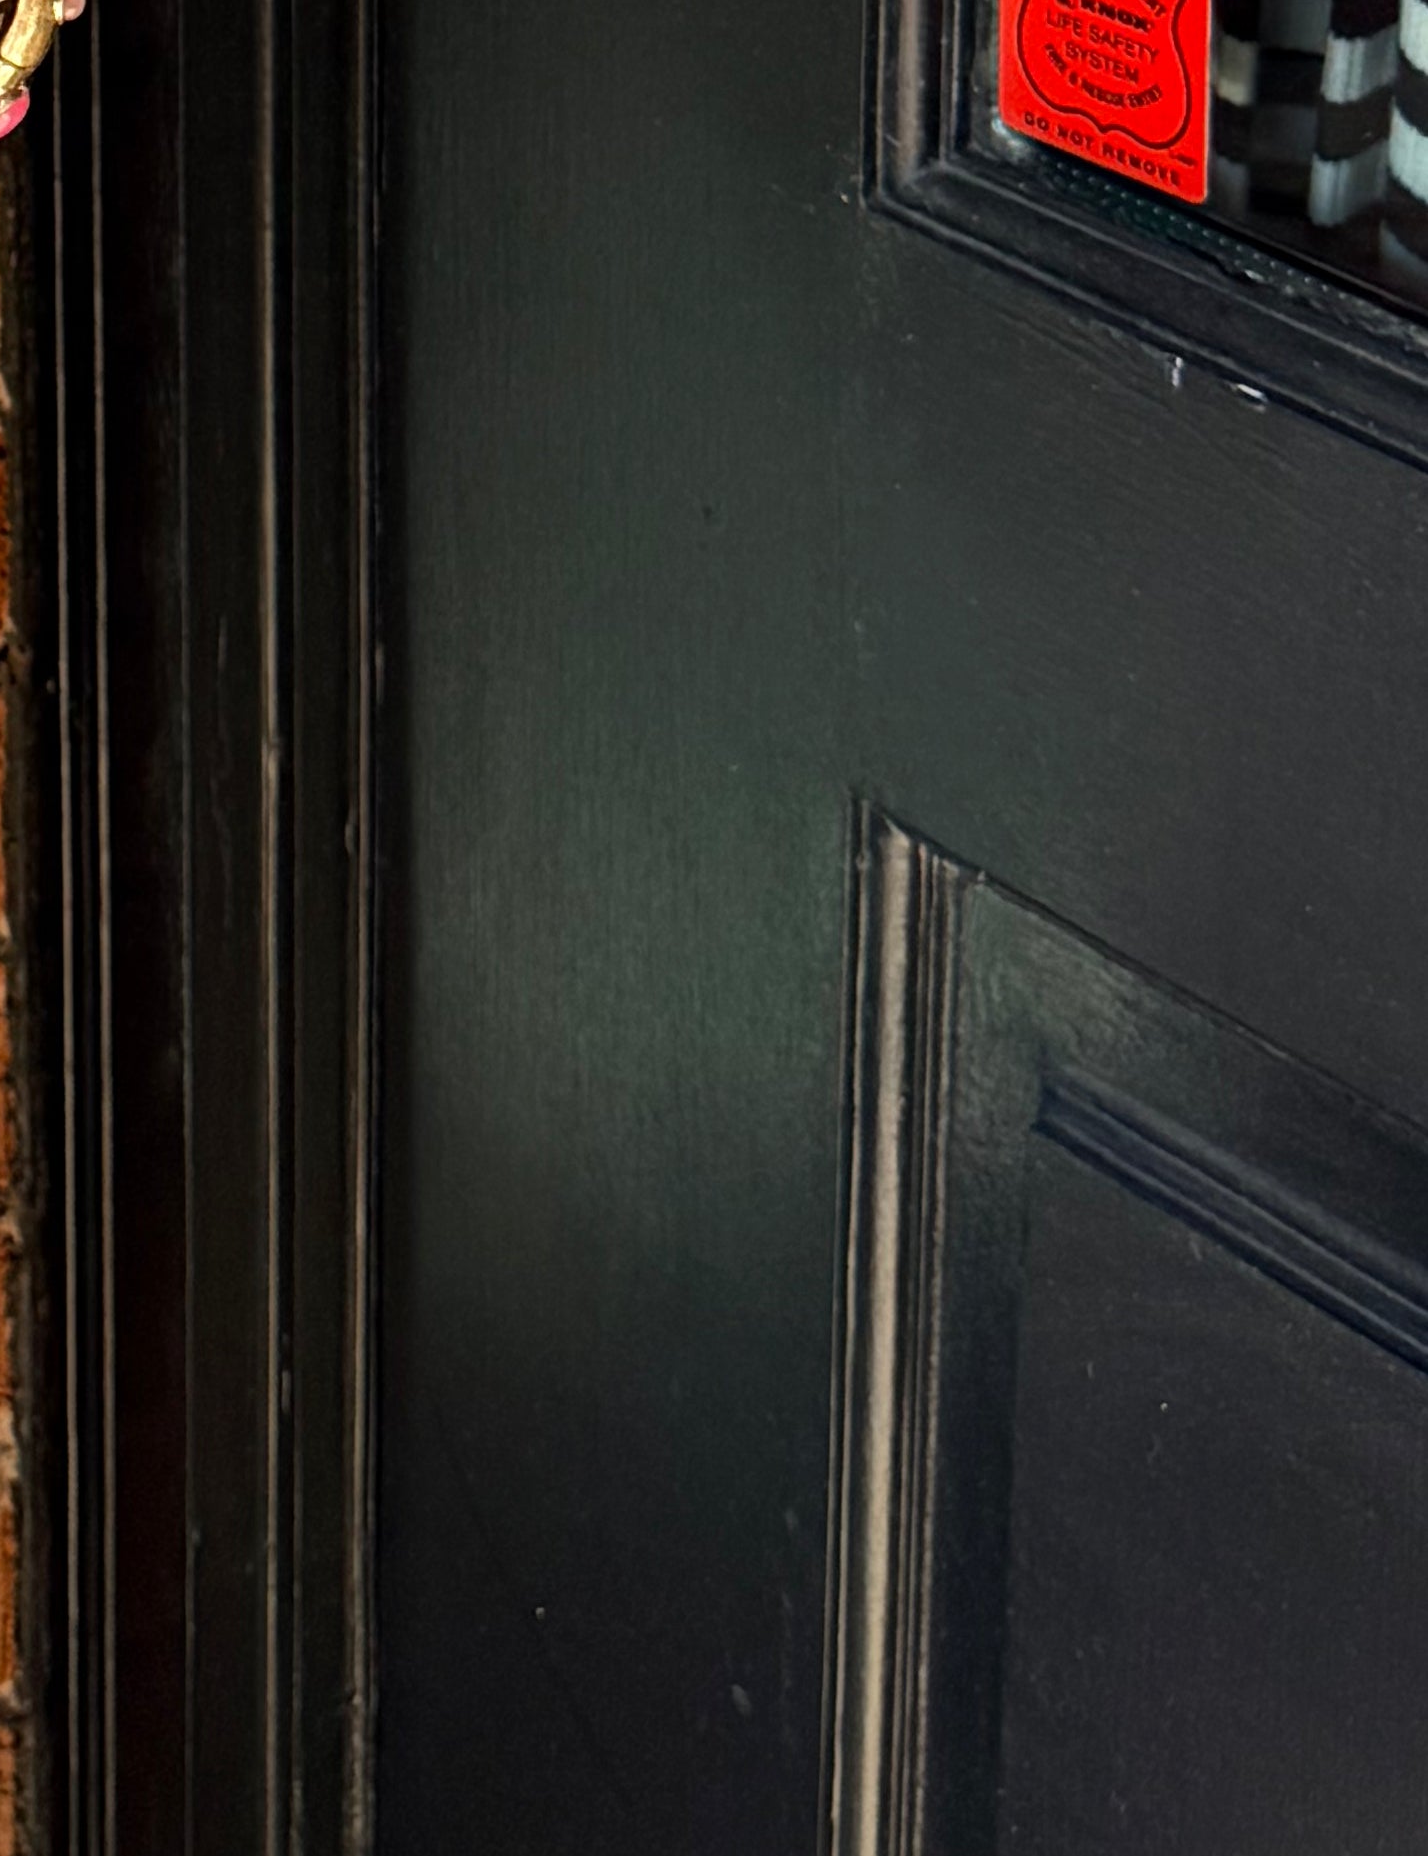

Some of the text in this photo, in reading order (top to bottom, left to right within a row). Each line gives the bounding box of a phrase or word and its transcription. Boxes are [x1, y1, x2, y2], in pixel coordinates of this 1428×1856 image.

[1046, 9, 1160, 63] LIFE SAFETY
[1065, 41, 1139, 84] SYSTEM
[1024, 111, 1049, 132] DO
[1057, 124, 1093, 151] NOT
[1102, 143, 1181, 187] REMOVE
